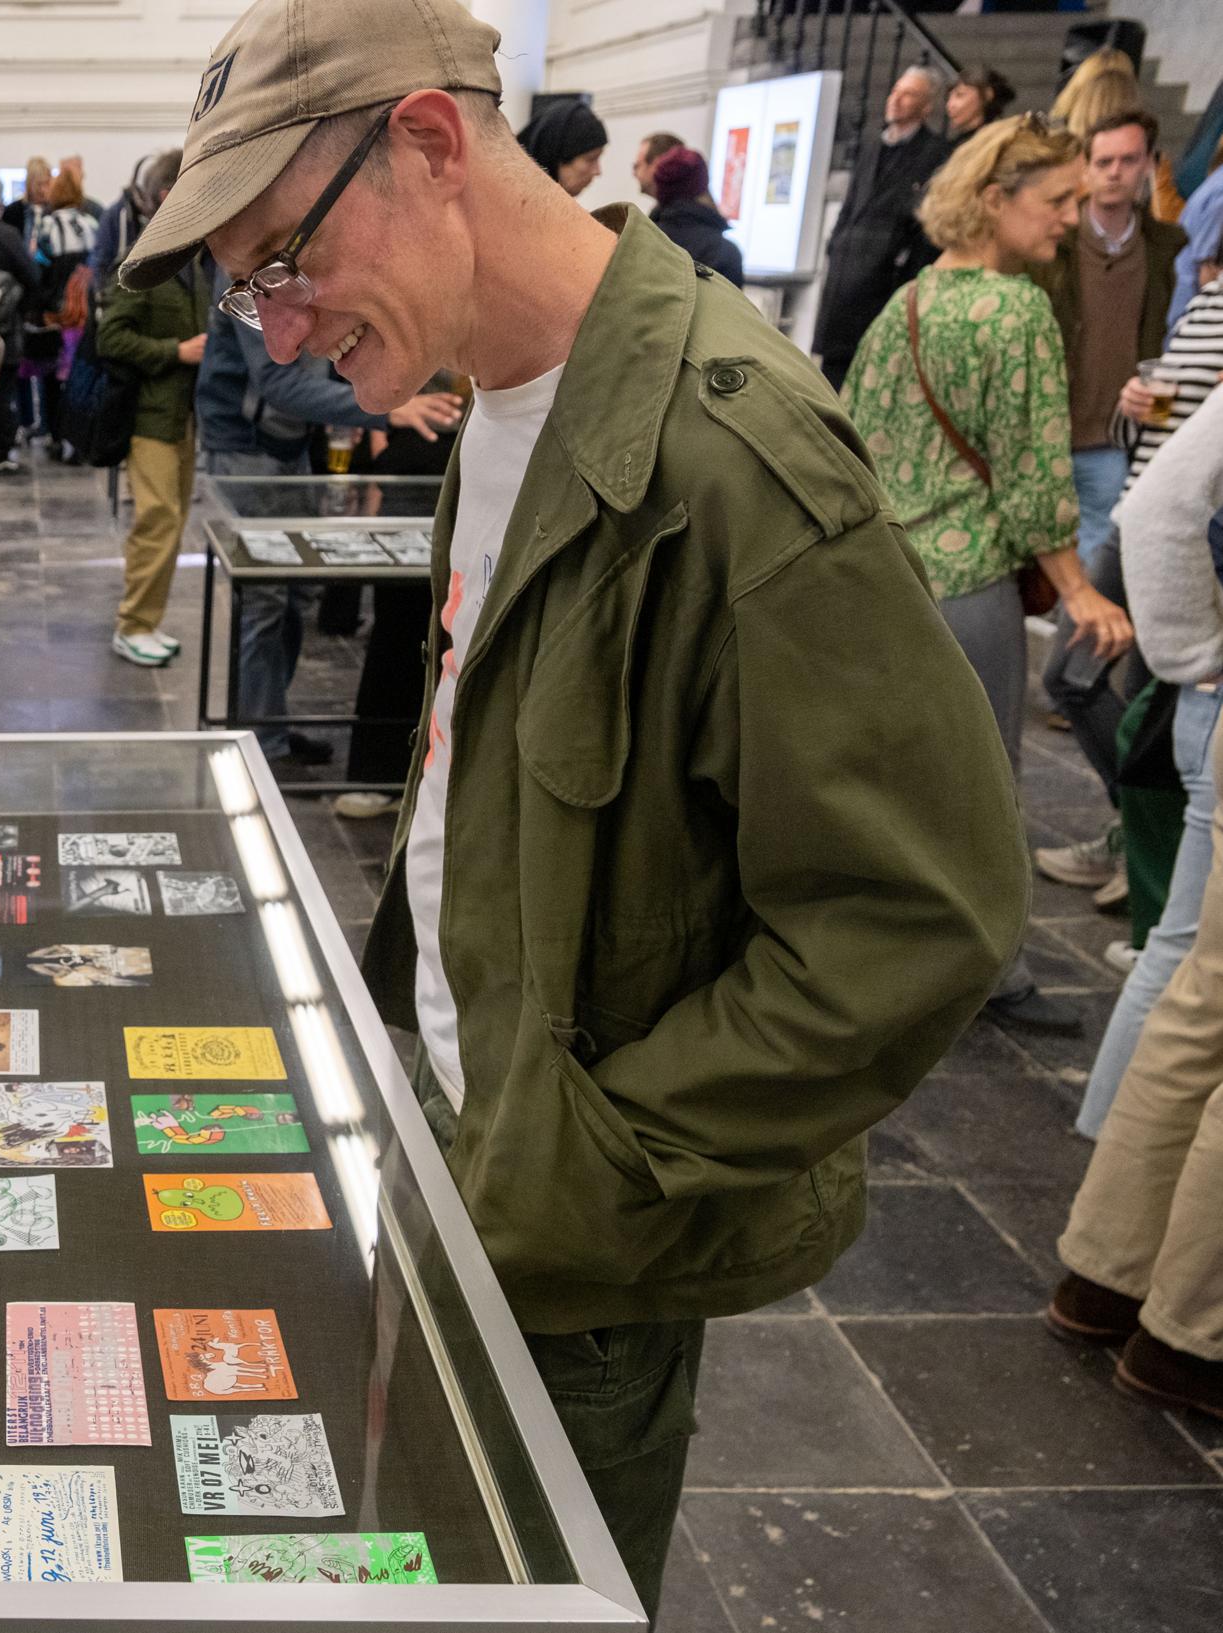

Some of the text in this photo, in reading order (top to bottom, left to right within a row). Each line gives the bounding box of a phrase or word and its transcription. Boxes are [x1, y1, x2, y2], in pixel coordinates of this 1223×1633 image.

[189, 1313, 215, 1351] 24 JUNI
[254, 1319, 285, 1377] TRAKTOR
[7, 1407, 18, 1444] UITERST
[18, 1396, 29, 1443] BELANGRIJK
[196, 1437, 221, 1465] MEI
[199, 1470, 222, 1487] 07
[3, 1493, 13, 1514] URSIN
[202, 1491, 226, 1511] VR
[39, 1510, 64, 1546] juni
[39, 1548, 56, 1564] 12
